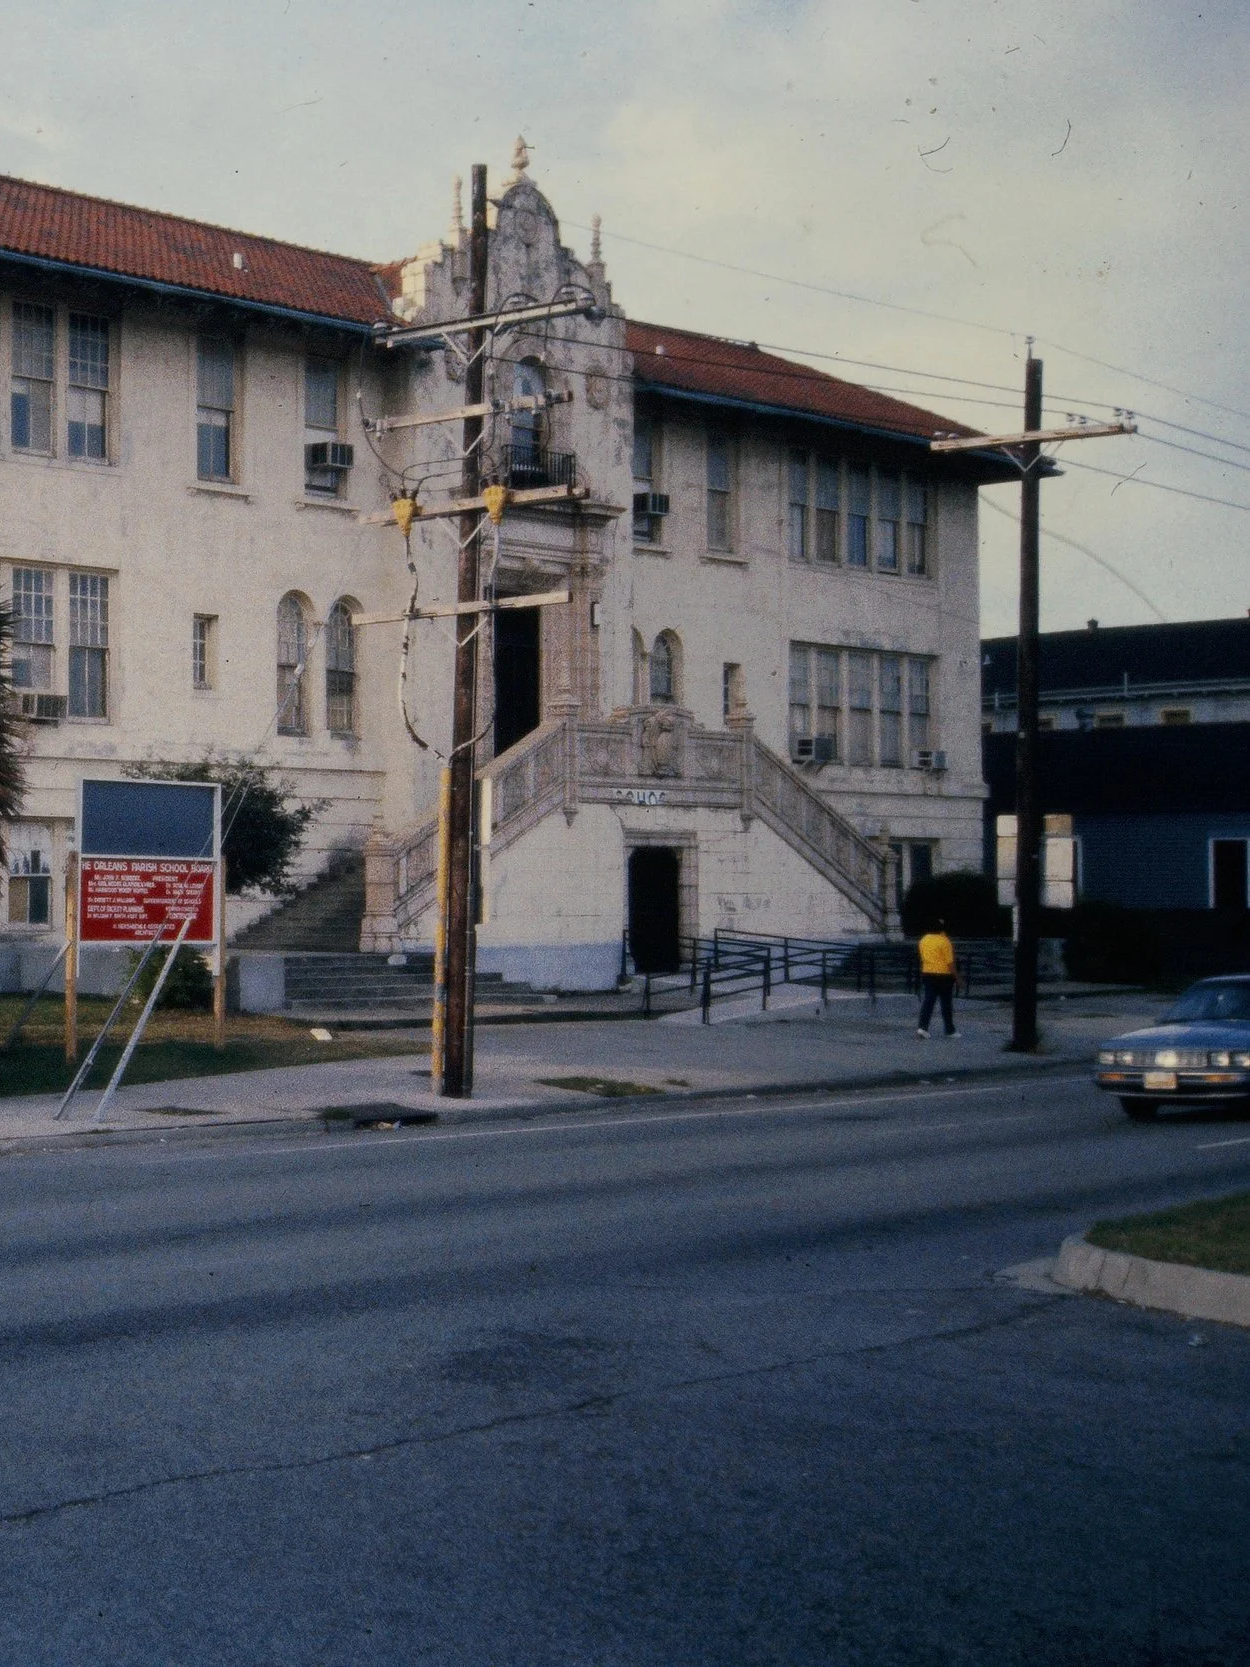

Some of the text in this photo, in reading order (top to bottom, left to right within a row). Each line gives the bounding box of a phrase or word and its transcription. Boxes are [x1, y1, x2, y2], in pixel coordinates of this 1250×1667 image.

[94, 861, 128, 871] ORLEANS
[131, 862, 157, 872] PARISH
[160, 863, 188, 873] SCHOOL
